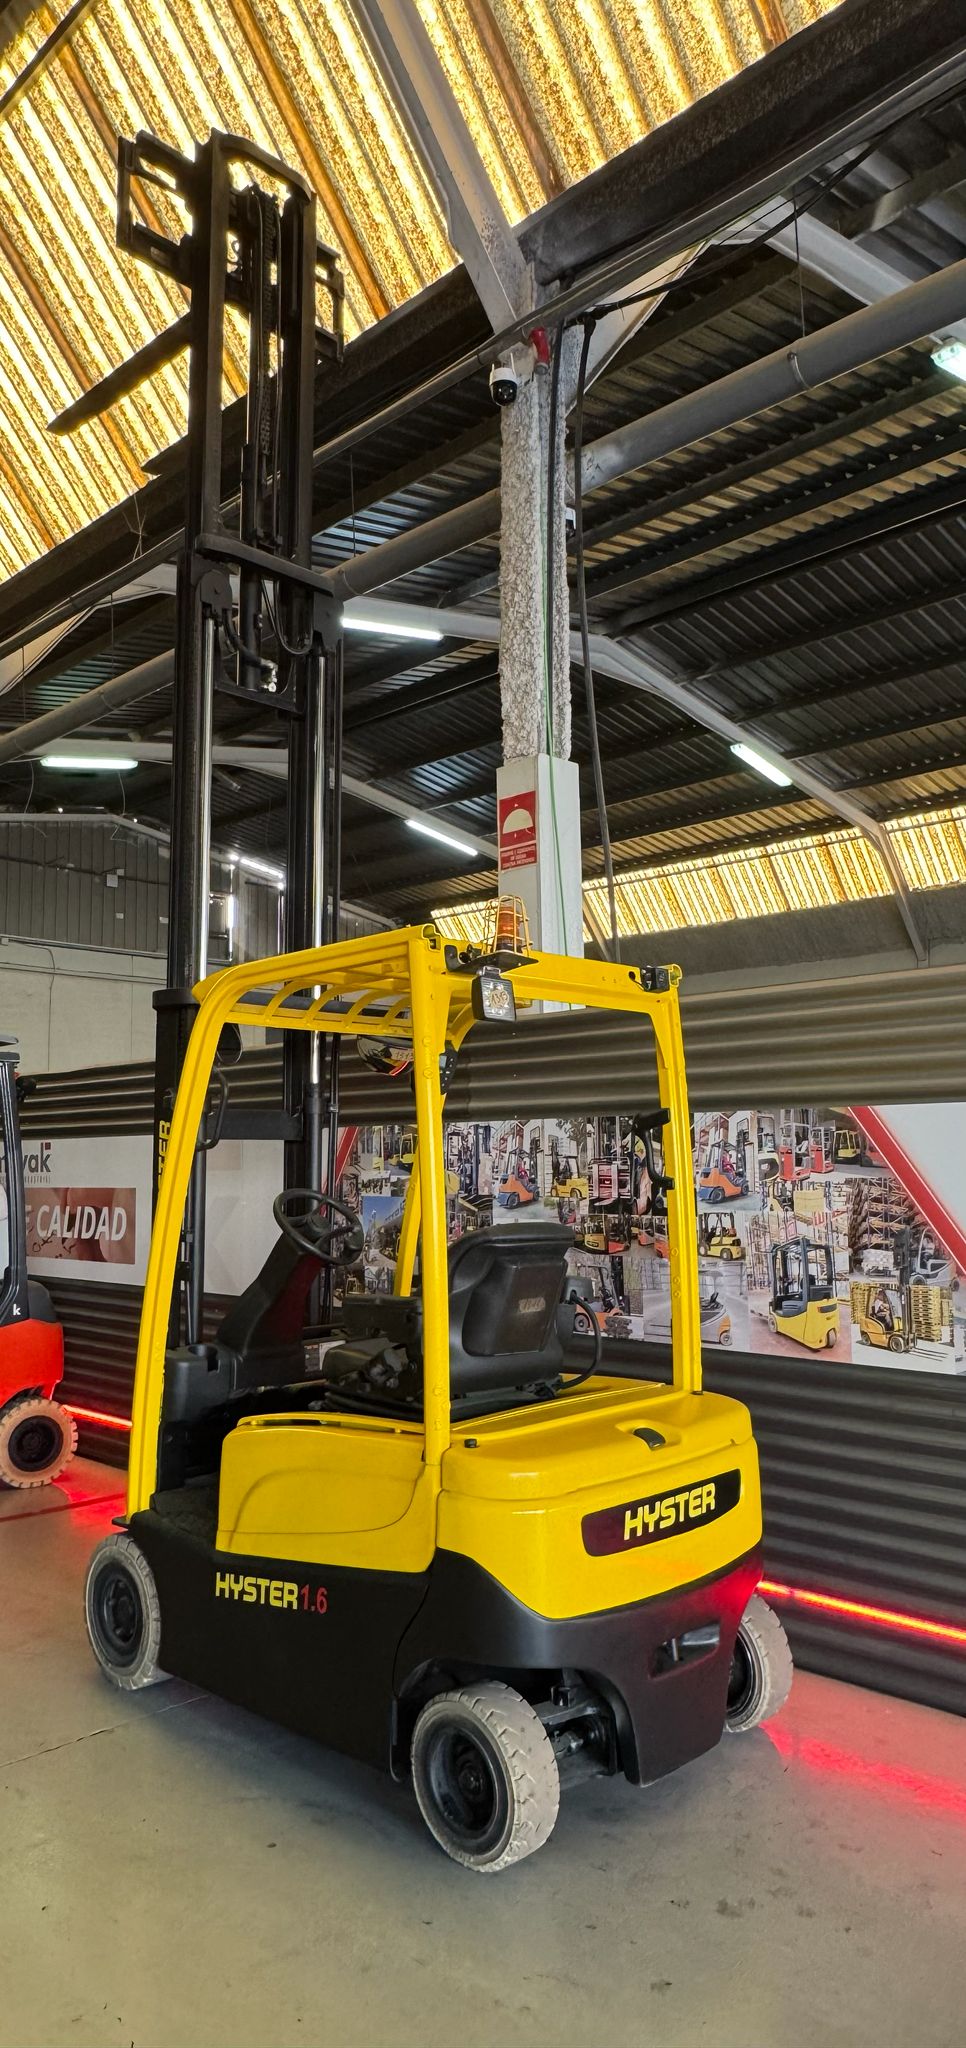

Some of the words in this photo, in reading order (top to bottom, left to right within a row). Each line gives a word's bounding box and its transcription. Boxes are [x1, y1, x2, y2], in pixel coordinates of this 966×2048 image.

[36, 1204, 127, 1241] CALIDAD
[623, 1482, 716, 1541] HYSTER
[215, 1571, 299, 1610] HYSTER
[300, 1583, 328, 1615] 1.6
